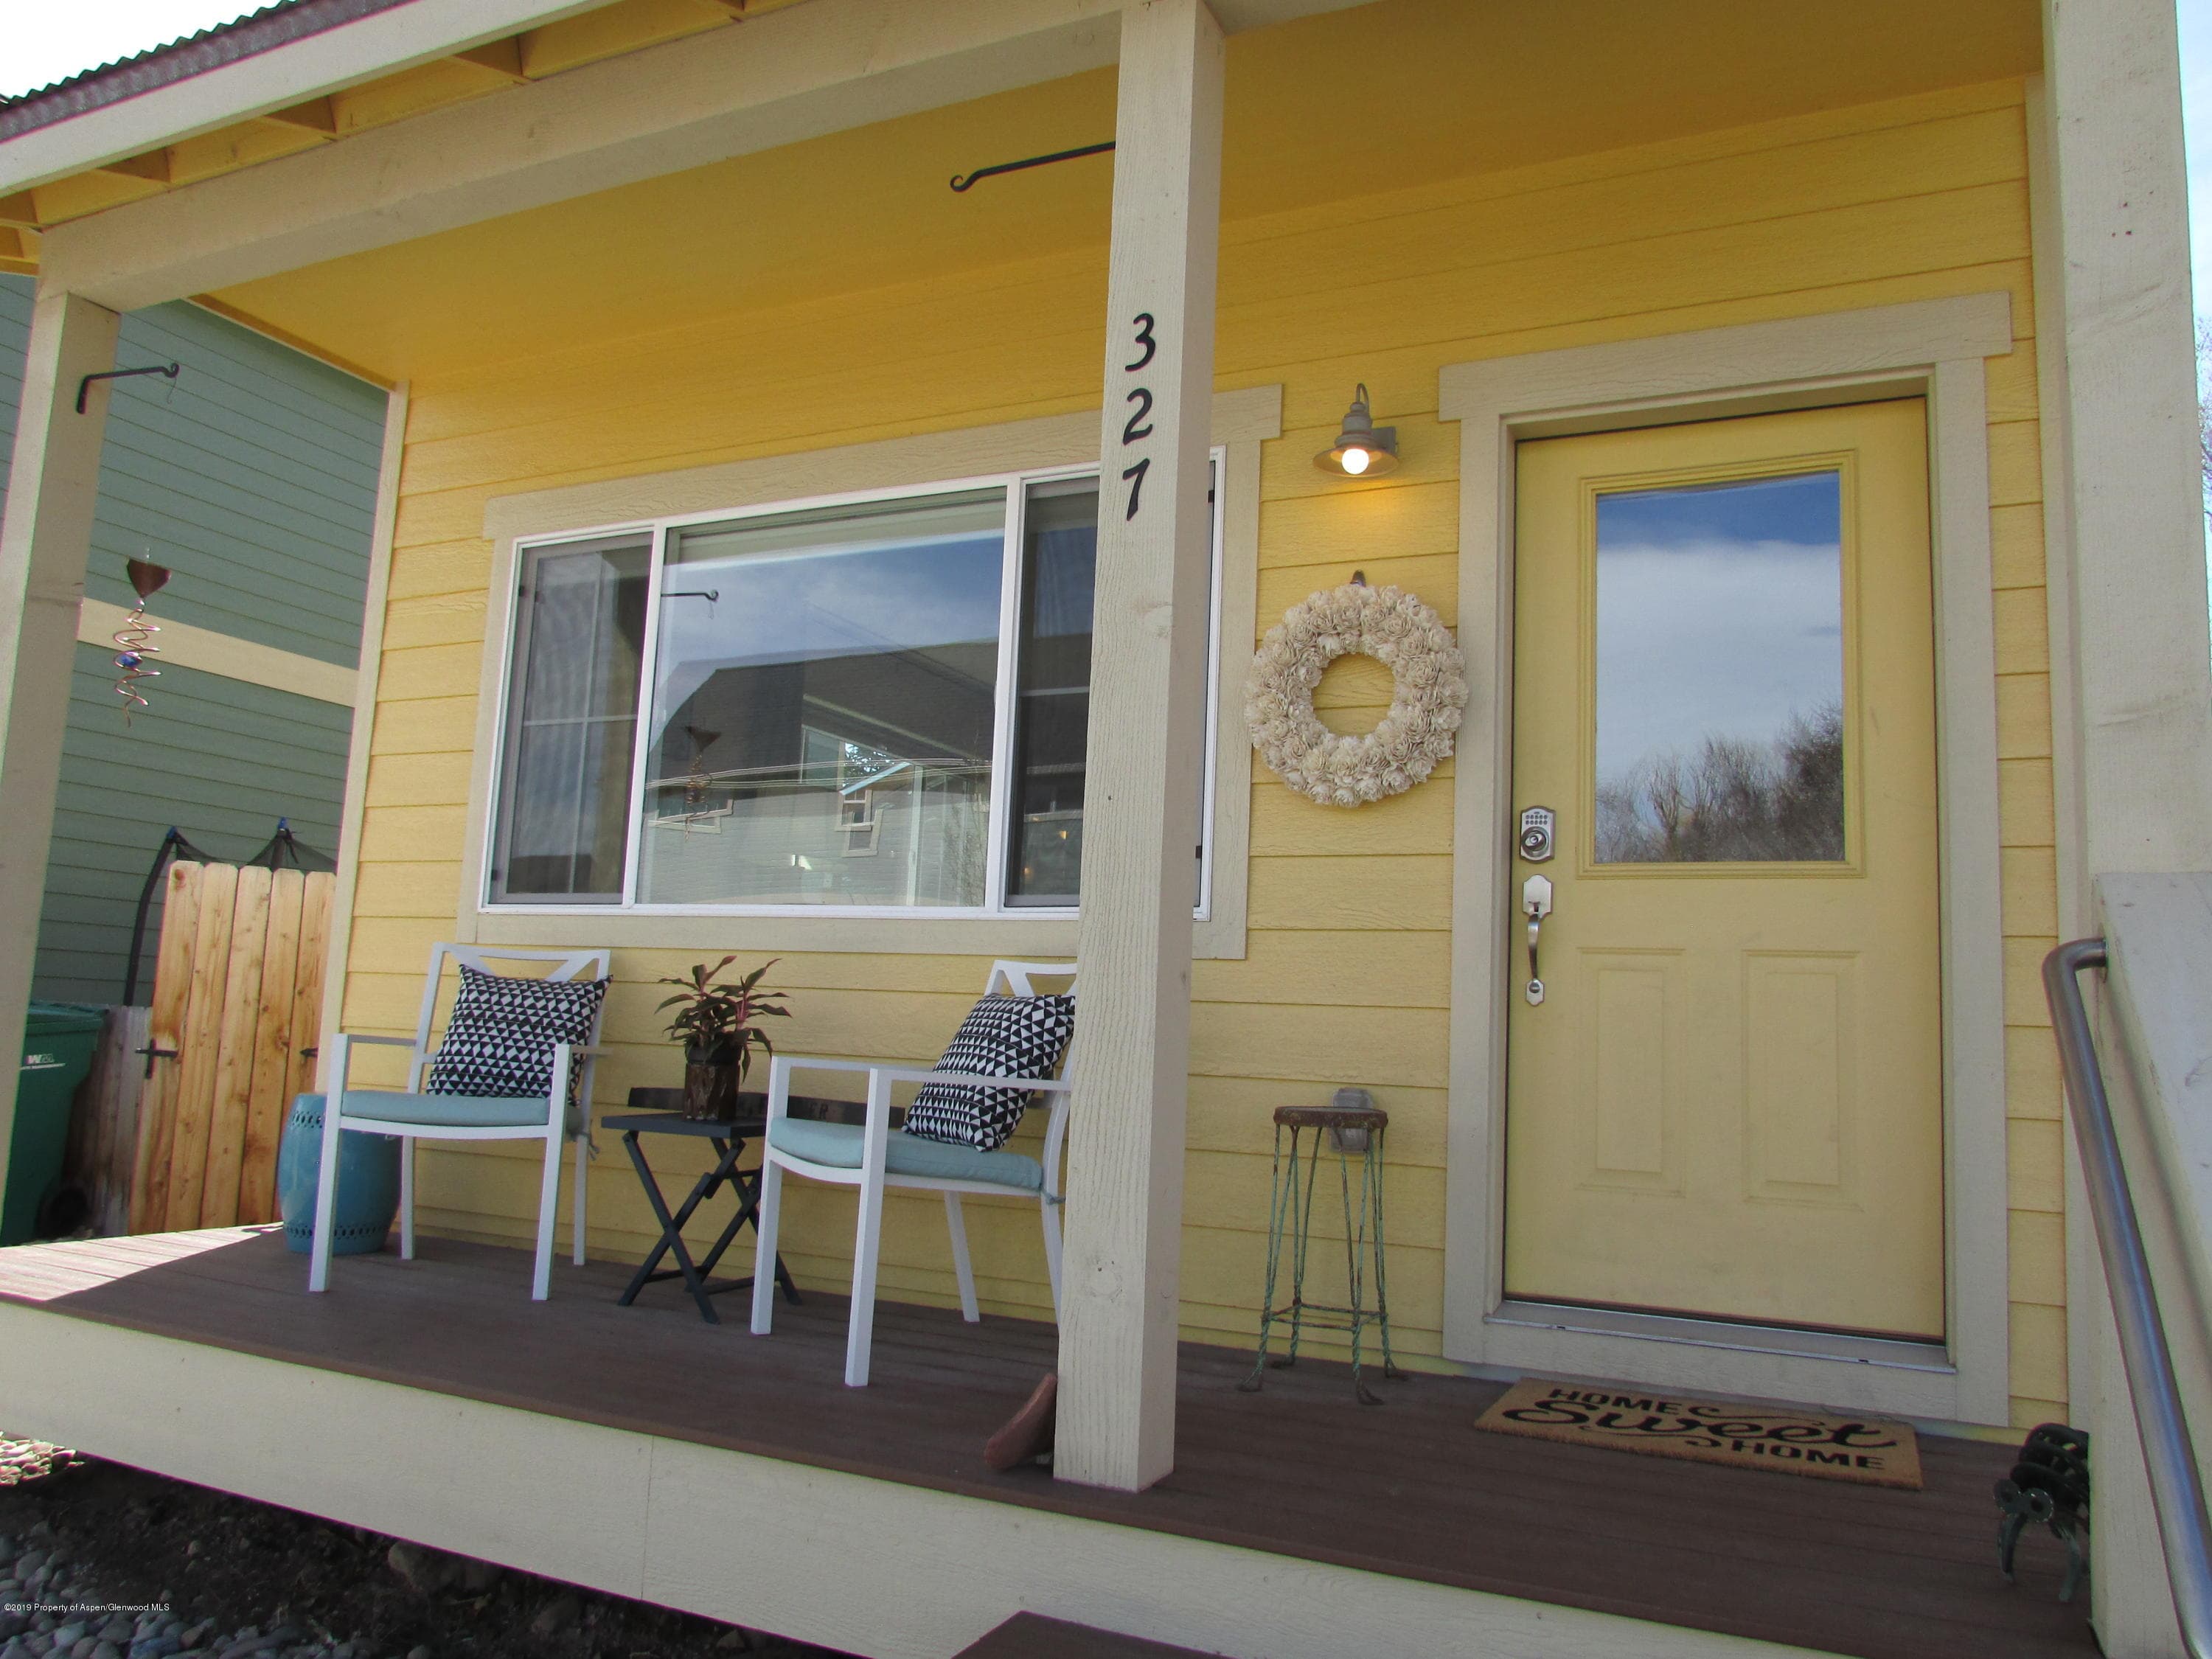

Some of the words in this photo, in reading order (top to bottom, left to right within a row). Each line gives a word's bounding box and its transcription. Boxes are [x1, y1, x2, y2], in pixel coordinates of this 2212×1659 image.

[1122, 313, 1156, 522] 327
[1548, 1388, 1683, 1416] HOME
[1502, 1399, 1897, 1448] Sweet
[1731, 1439, 1885, 1470] HOME
